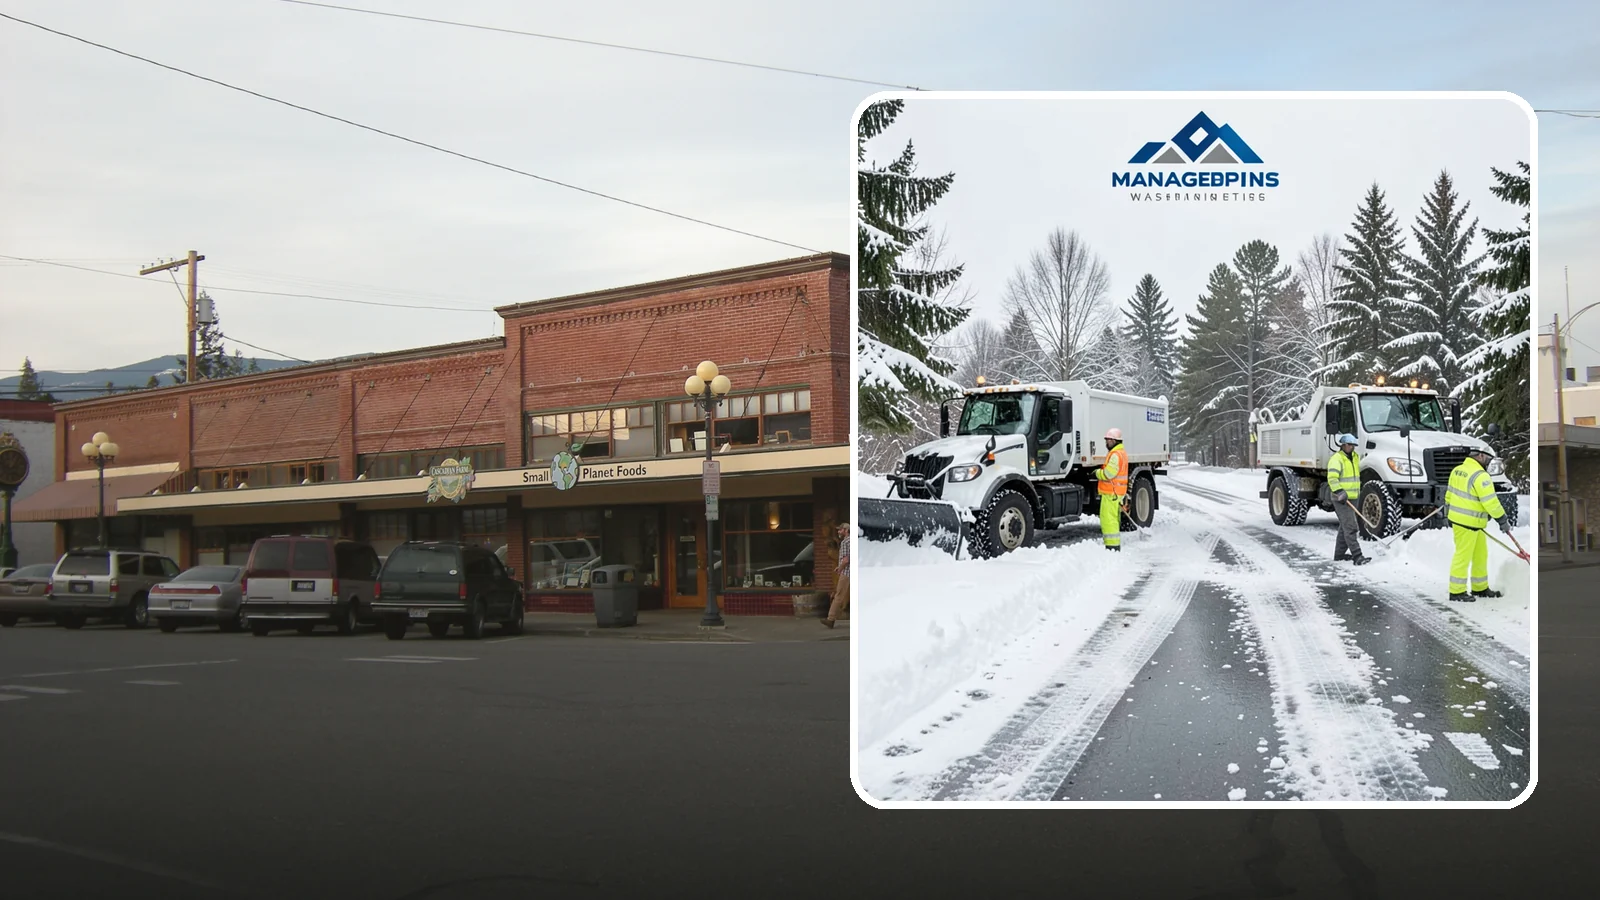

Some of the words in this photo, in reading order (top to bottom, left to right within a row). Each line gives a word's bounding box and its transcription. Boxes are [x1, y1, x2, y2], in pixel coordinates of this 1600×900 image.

[523, 471, 549, 483] Small
[583, 467, 614, 479] Planet
[617, 464, 647, 477] Foods
